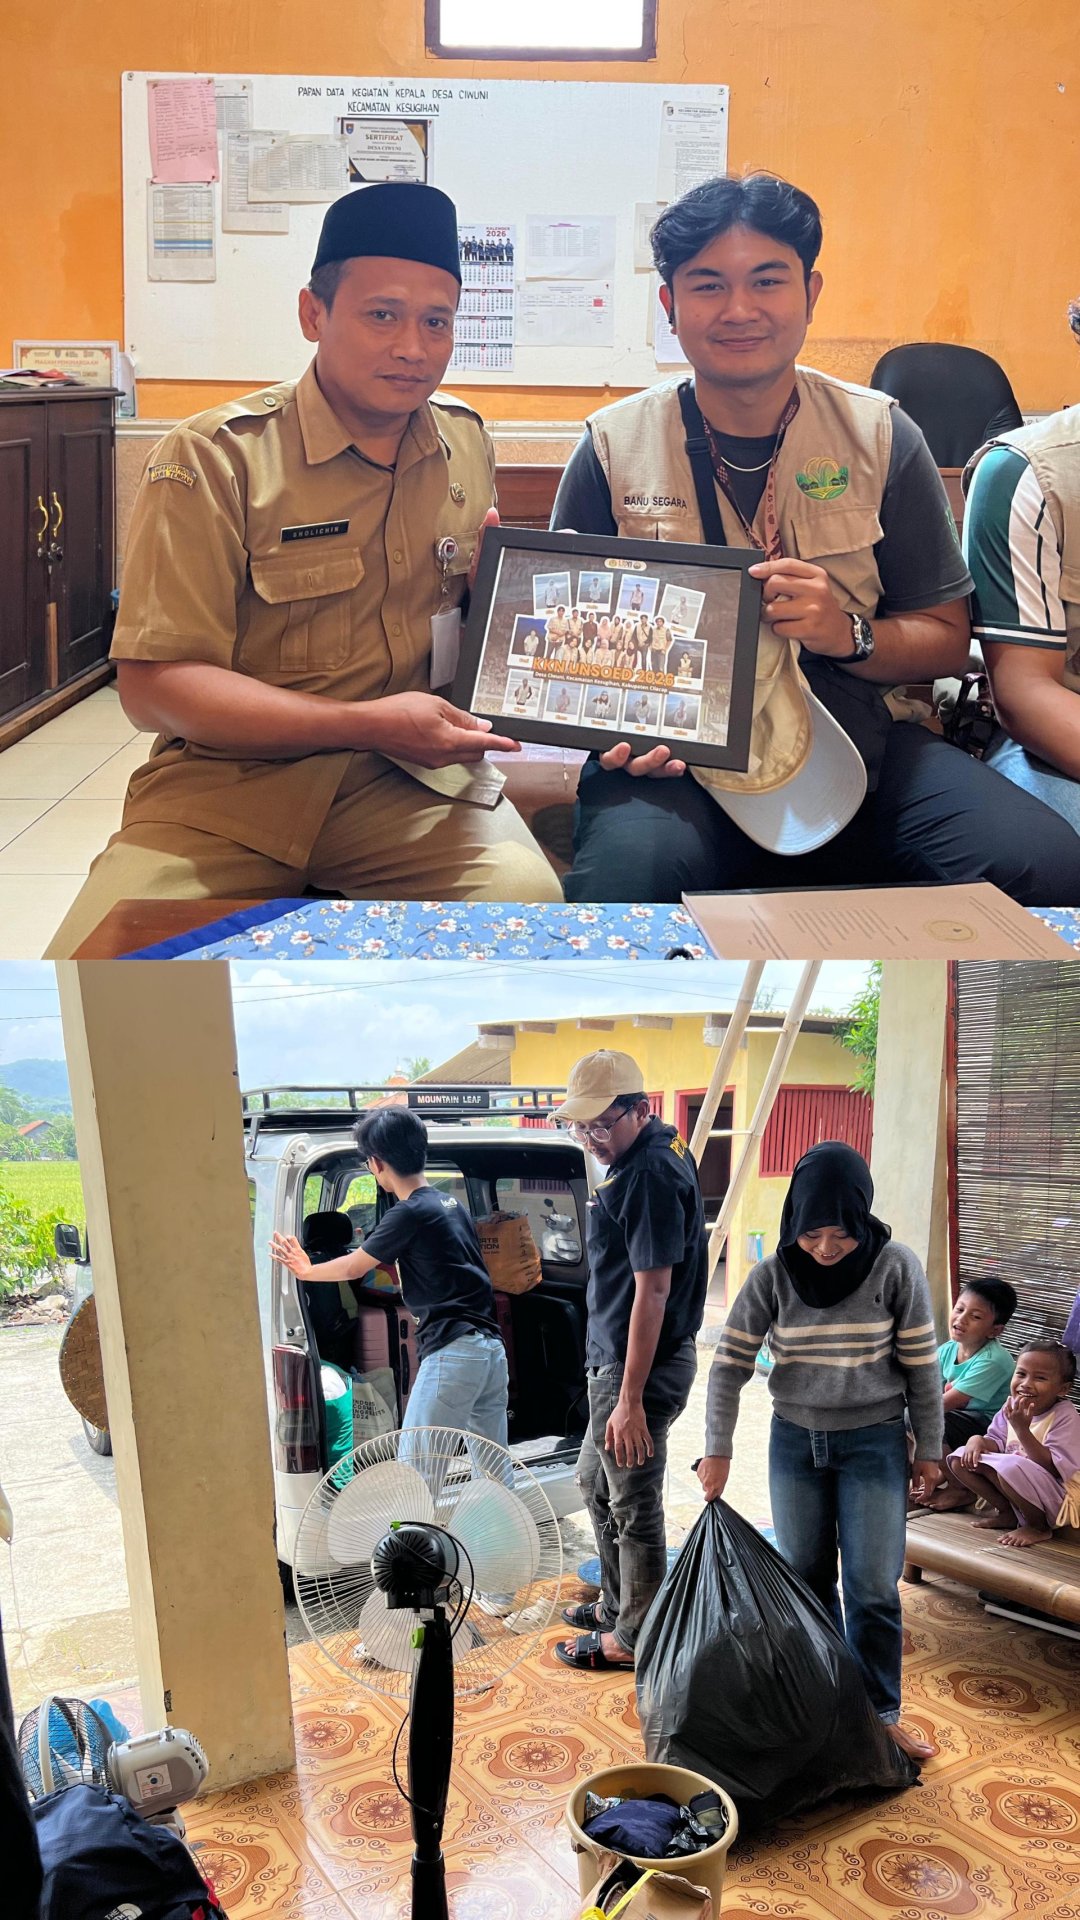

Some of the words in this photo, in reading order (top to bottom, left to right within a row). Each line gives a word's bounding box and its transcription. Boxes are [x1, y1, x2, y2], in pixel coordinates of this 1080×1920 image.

[298, 87, 321, 97] PAPAN
[326, 88, 345, 97] DATA
[352, 88, 389, 98] KEGIATAN
[395, 89, 426, 98] KEPALA
[432, 90, 453, 99] DESA
[459, 90, 489, 100] CIWUNI
[347, 102, 391, 112] KECAMATAN
[396, 102, 440, 113] KESUGIHAN
[624, 496, 649, 506] BANU
[652, 496, 688, 509] SEGARA
[533, 657, 566, 673] KKN
[569, 661, 633, 681] UNSOED
[636, 669, 675, 687] 2026
[417, 1095, 459, 1104] MOUNTAIN
[463, 1095, 482, 1104] LEAF
[104, 1908, 120, 1920] THE
